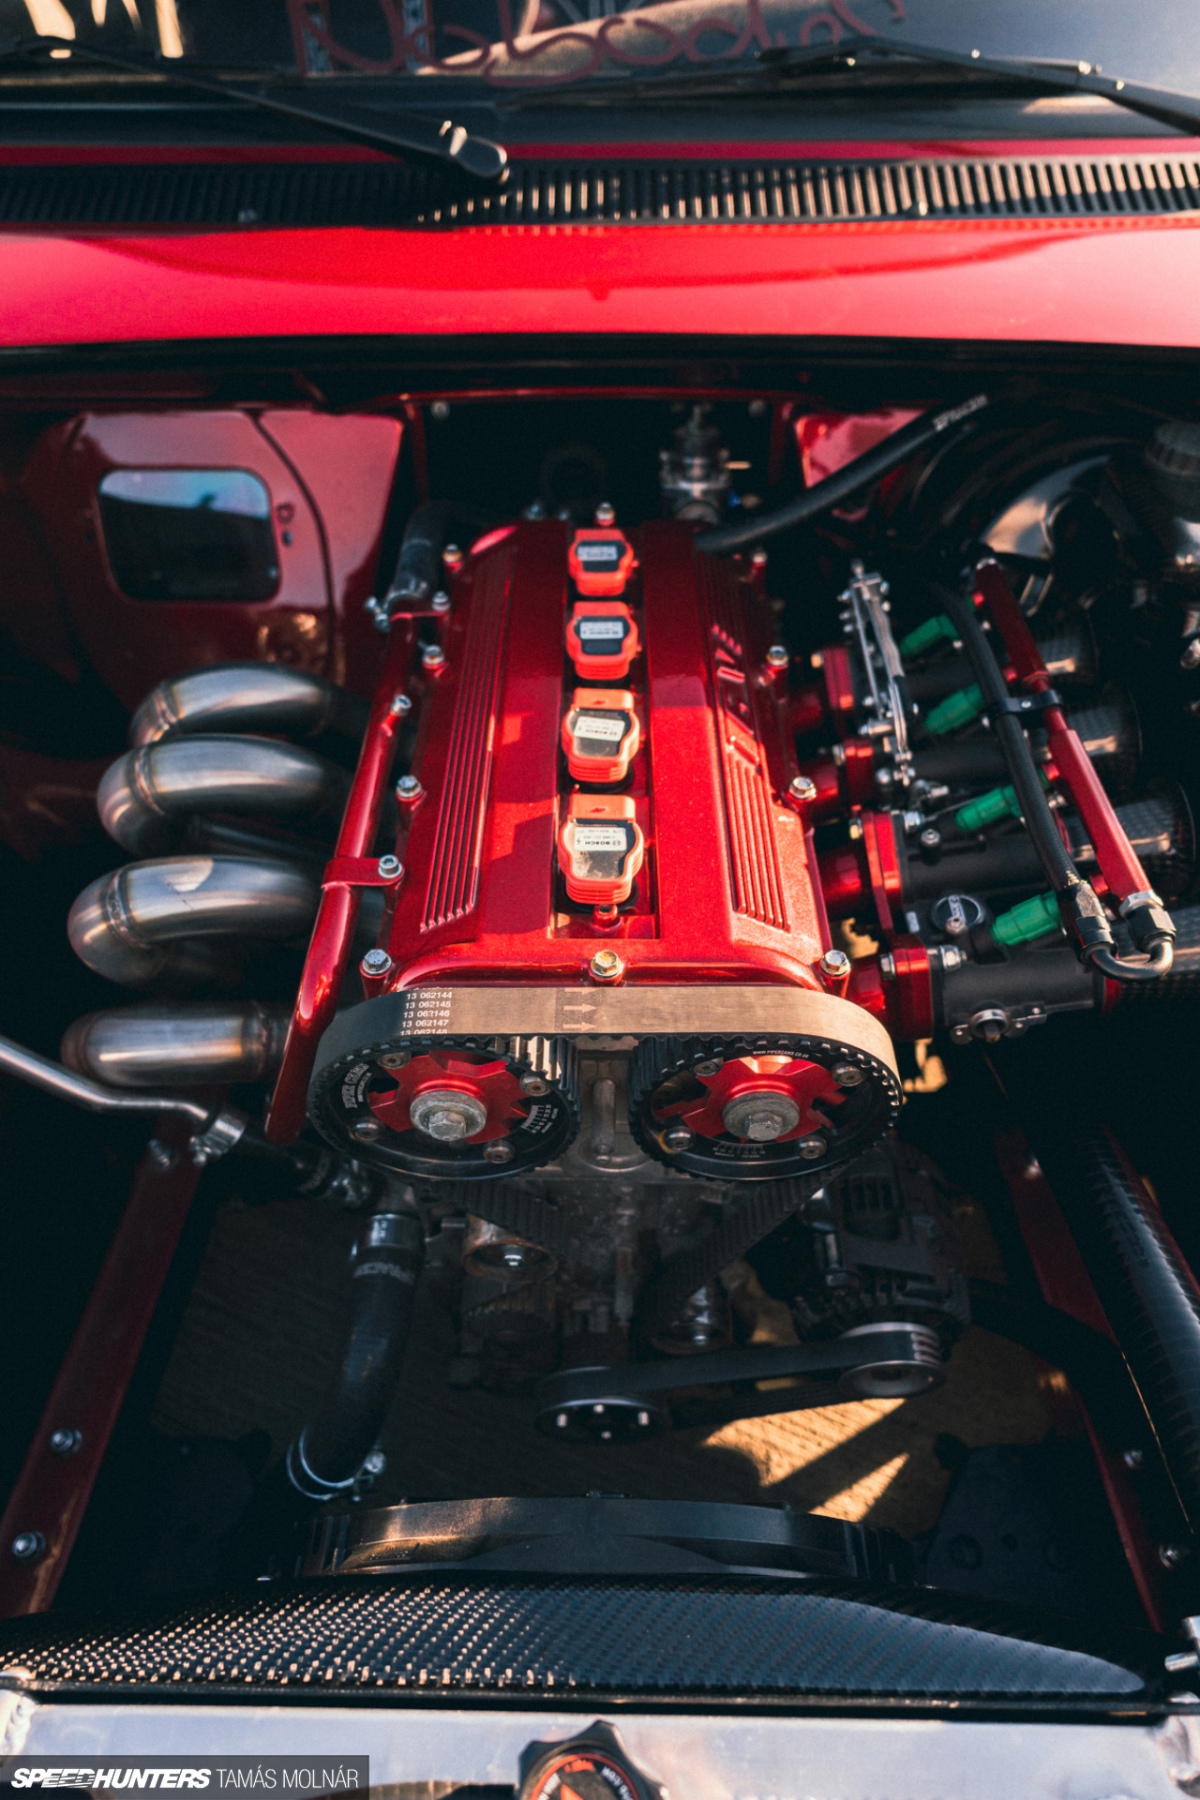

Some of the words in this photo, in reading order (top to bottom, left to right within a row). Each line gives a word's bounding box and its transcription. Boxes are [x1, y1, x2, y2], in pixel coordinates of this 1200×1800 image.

[406, 992, 417, 1000] 13
[419, 991, 453, 999] 062144
[405, 1001, 416, 1010] 13
[418, 1000, 451, 1009] 062145
[403, 1010, 414, 1019] 13
[416, 1009, 450, 1018] 062146
[401, 1020, 413, 1028] 13
[415, 1019, 449, 1027] 062147
